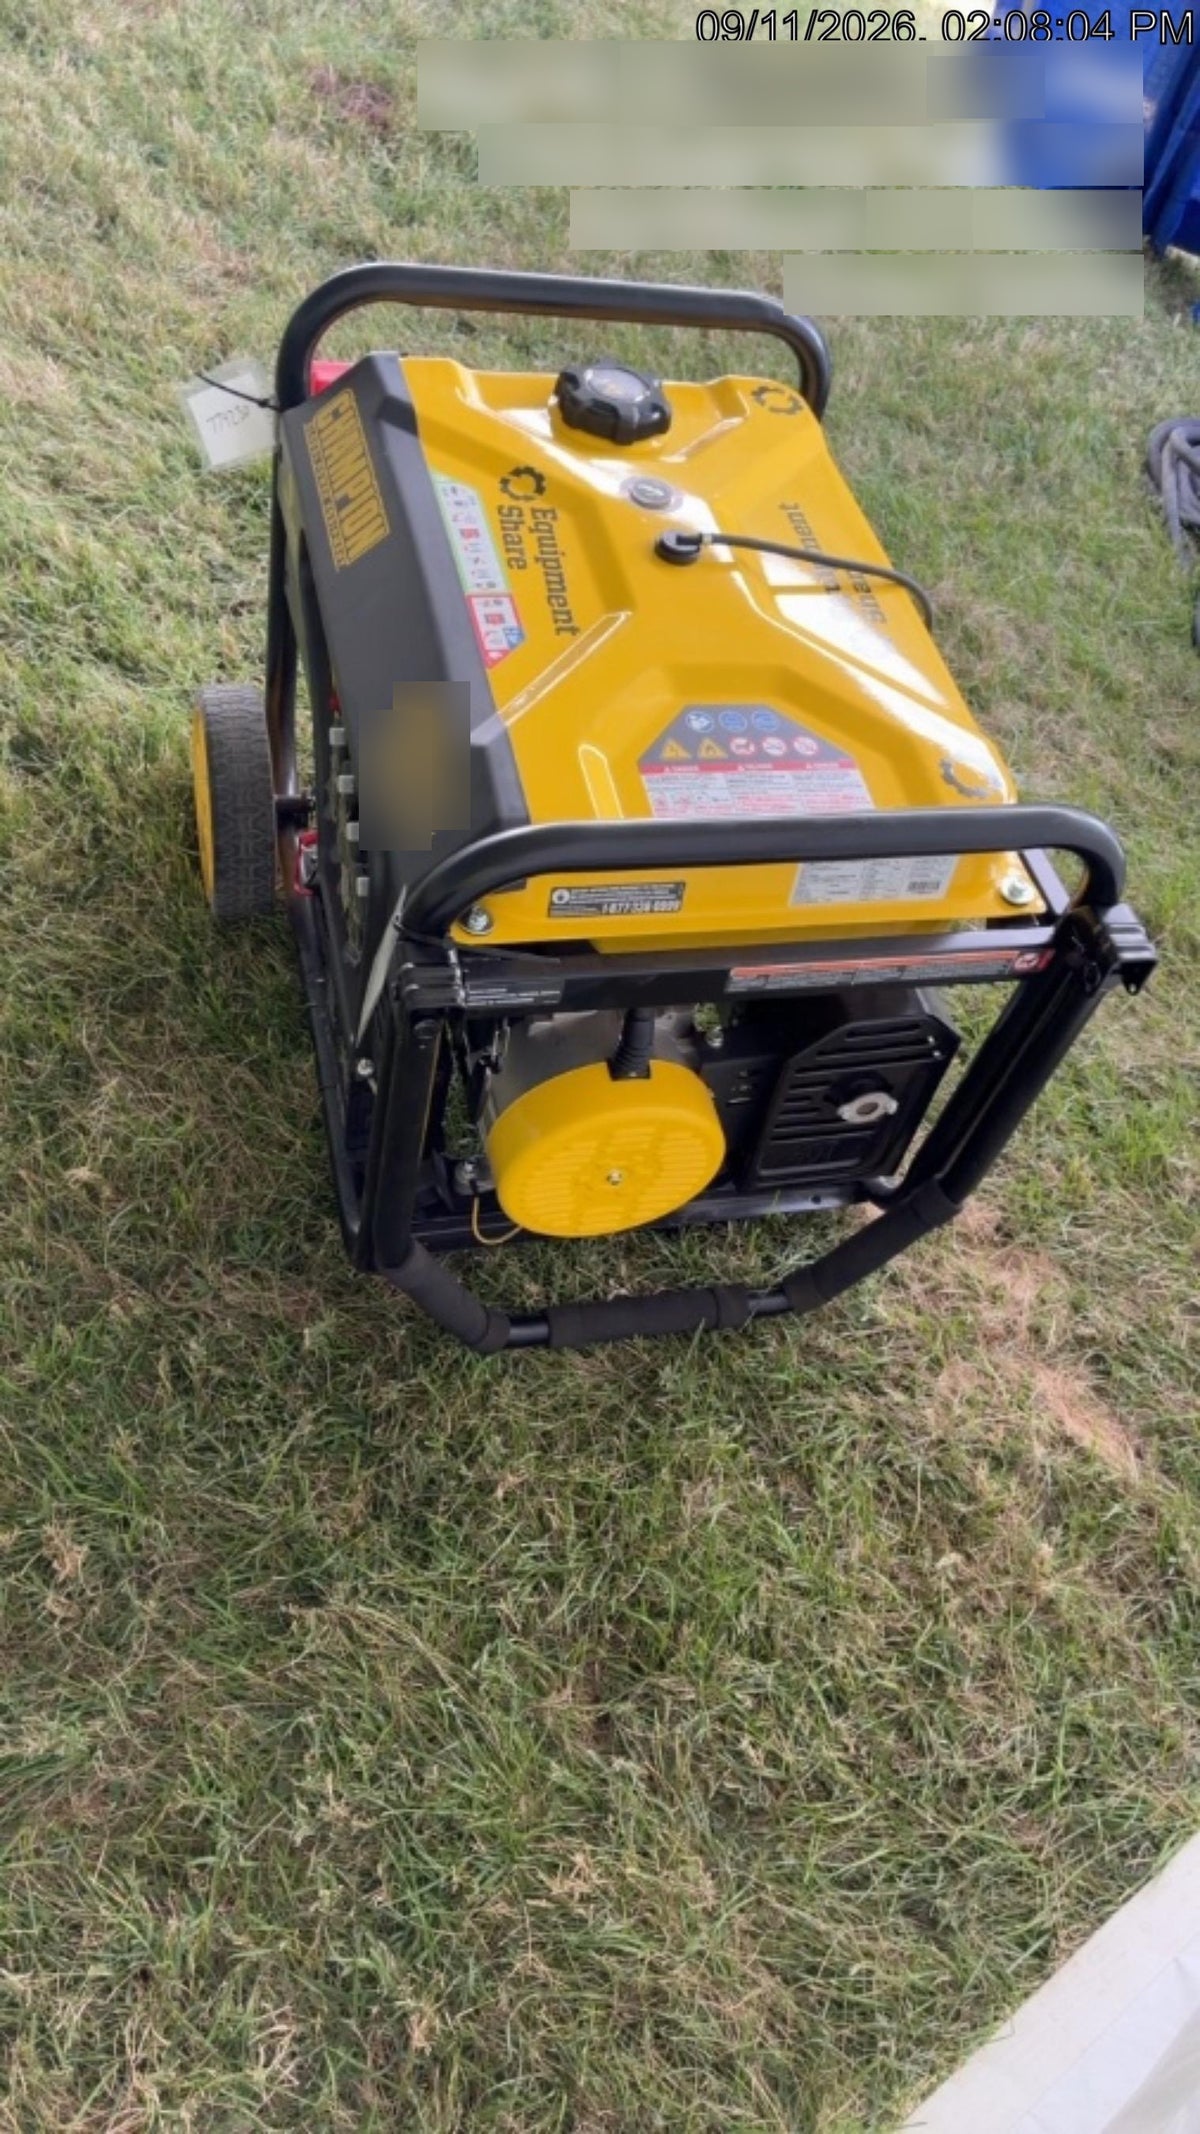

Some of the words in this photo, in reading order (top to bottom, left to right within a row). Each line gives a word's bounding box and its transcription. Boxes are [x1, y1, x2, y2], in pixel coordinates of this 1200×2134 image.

[315, 389, 389, 565] CHAMPION
[497, 504, 528, 570] Share
[529, 506, 581, 636] Equipment
